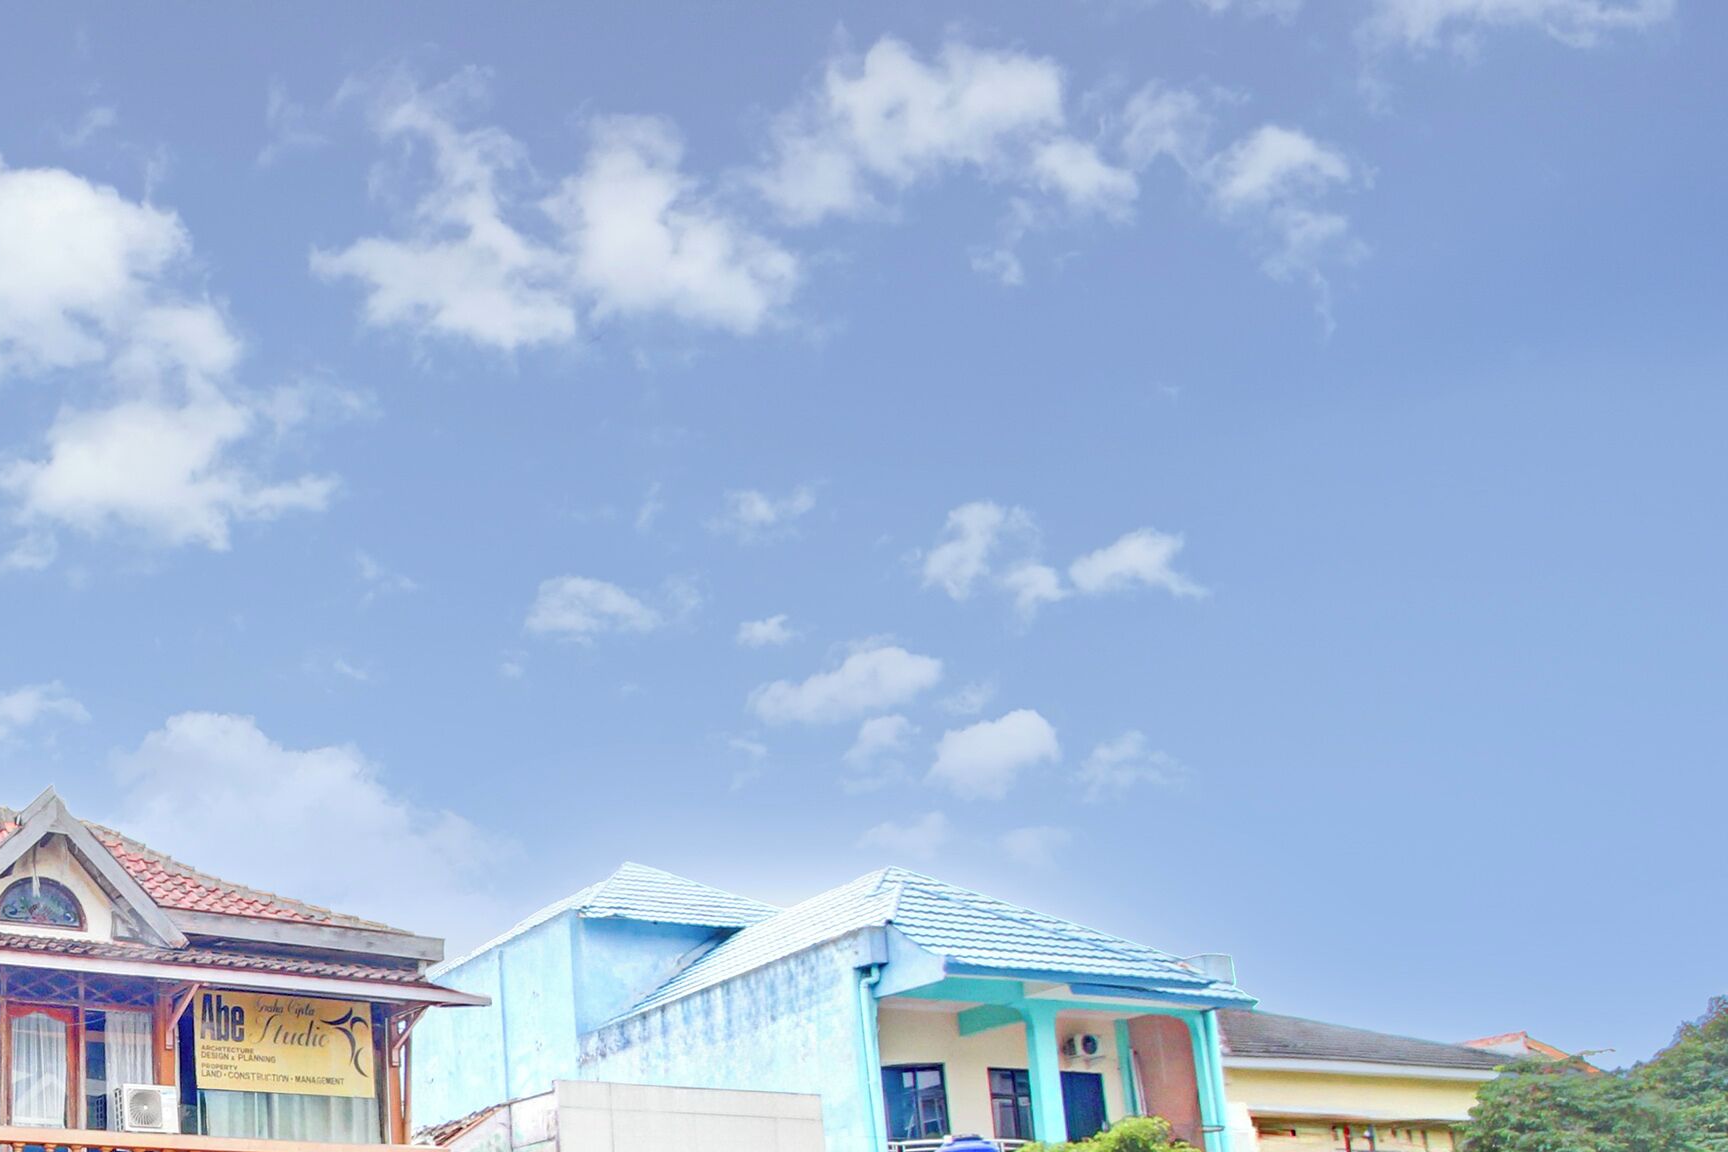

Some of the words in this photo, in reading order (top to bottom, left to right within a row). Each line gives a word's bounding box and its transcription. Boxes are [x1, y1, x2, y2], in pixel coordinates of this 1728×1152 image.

[200, 993, 245, 1042] Abe
[250, 1014, 330, 1048] Studio
[201, 1045, 254, 1054] ARCHITECTURE
[201, 1052, 229, 1061] DESIGN
[238, 1054, 276, 1064] PLANNING
[201, 1063, 238, 1071] PROPERTY
